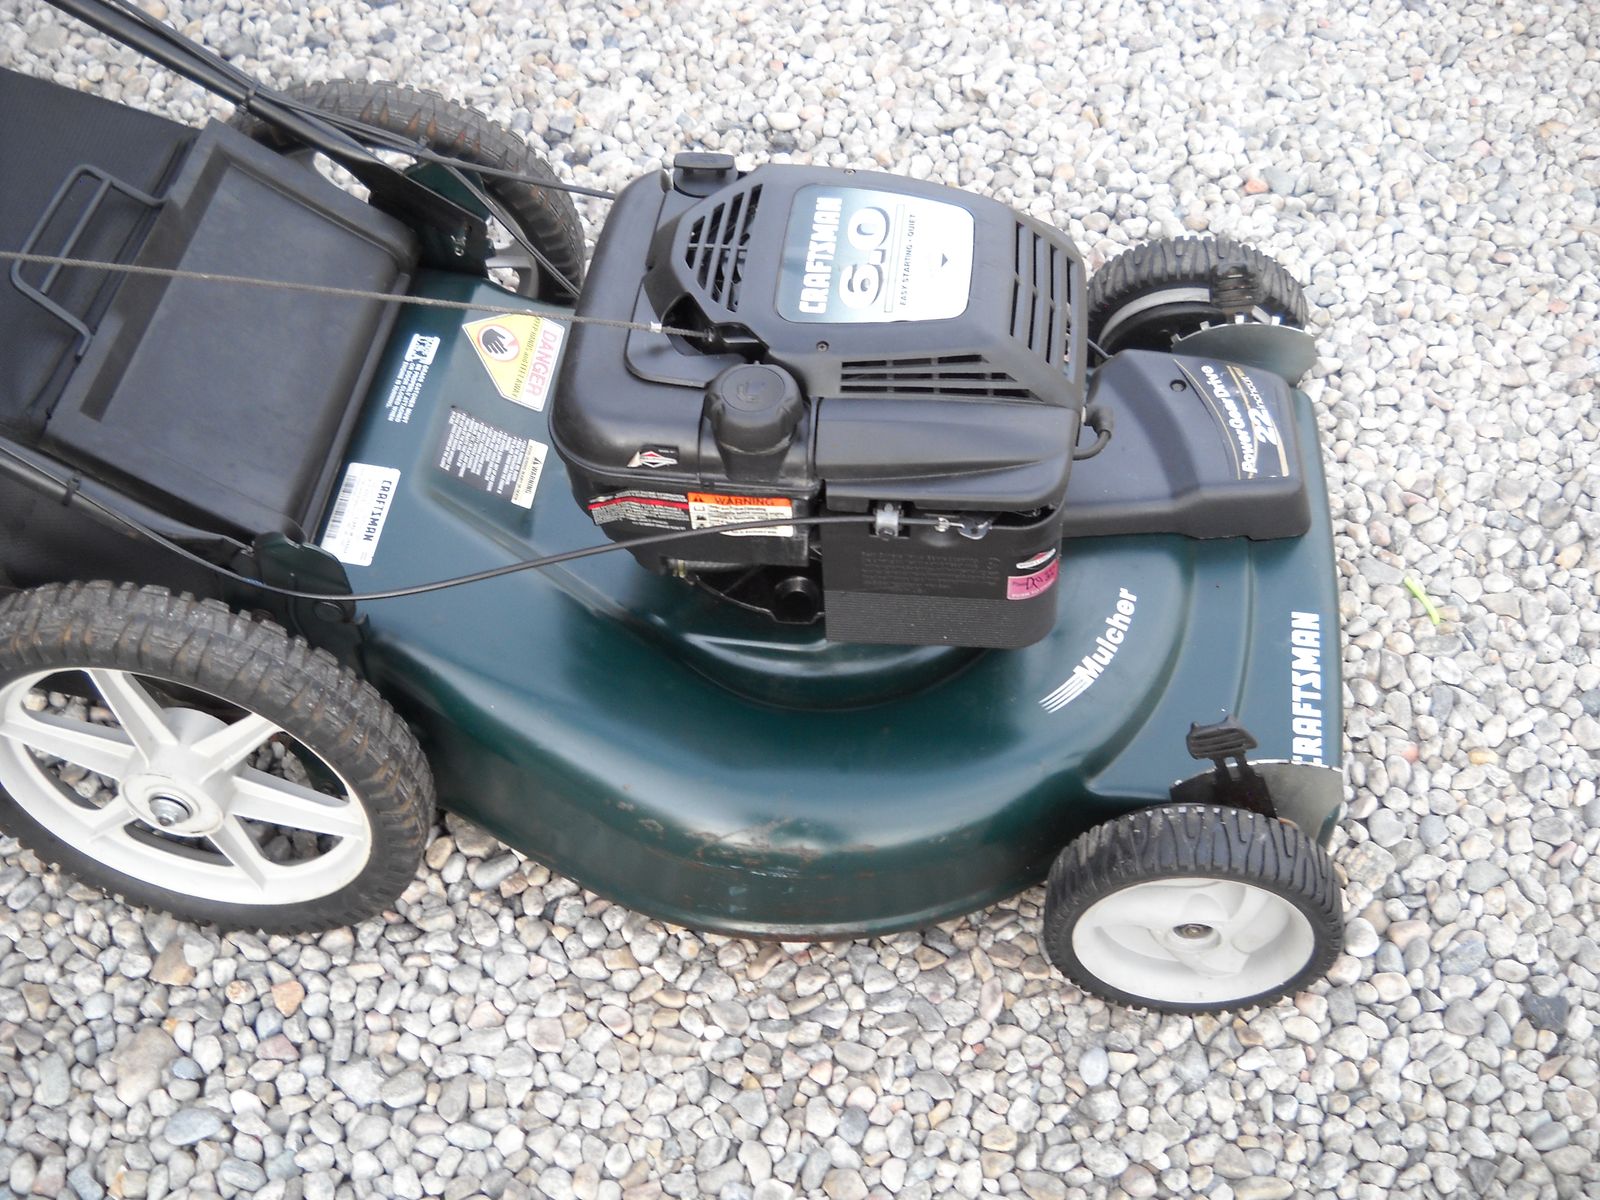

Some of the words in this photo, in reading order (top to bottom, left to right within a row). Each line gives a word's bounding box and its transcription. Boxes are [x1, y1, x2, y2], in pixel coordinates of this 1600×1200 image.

[798, 197, 843, 314] CRAFTSMAN
[838, 206, 889, 309] 6.0
[901, 244, 913, 284] STARTING
[899, 284, 909, 306] EASY
[525, 330, 557, 397] DANGER
[1247, 407, 1279, 447] 22
[525, 465, 538, 495] WARNING
[714, 496, 775, 506] WARNING
[363, 479, 393, 543] CRAFTSMAN
[1072, 587, 1138, 680] Mulcher
